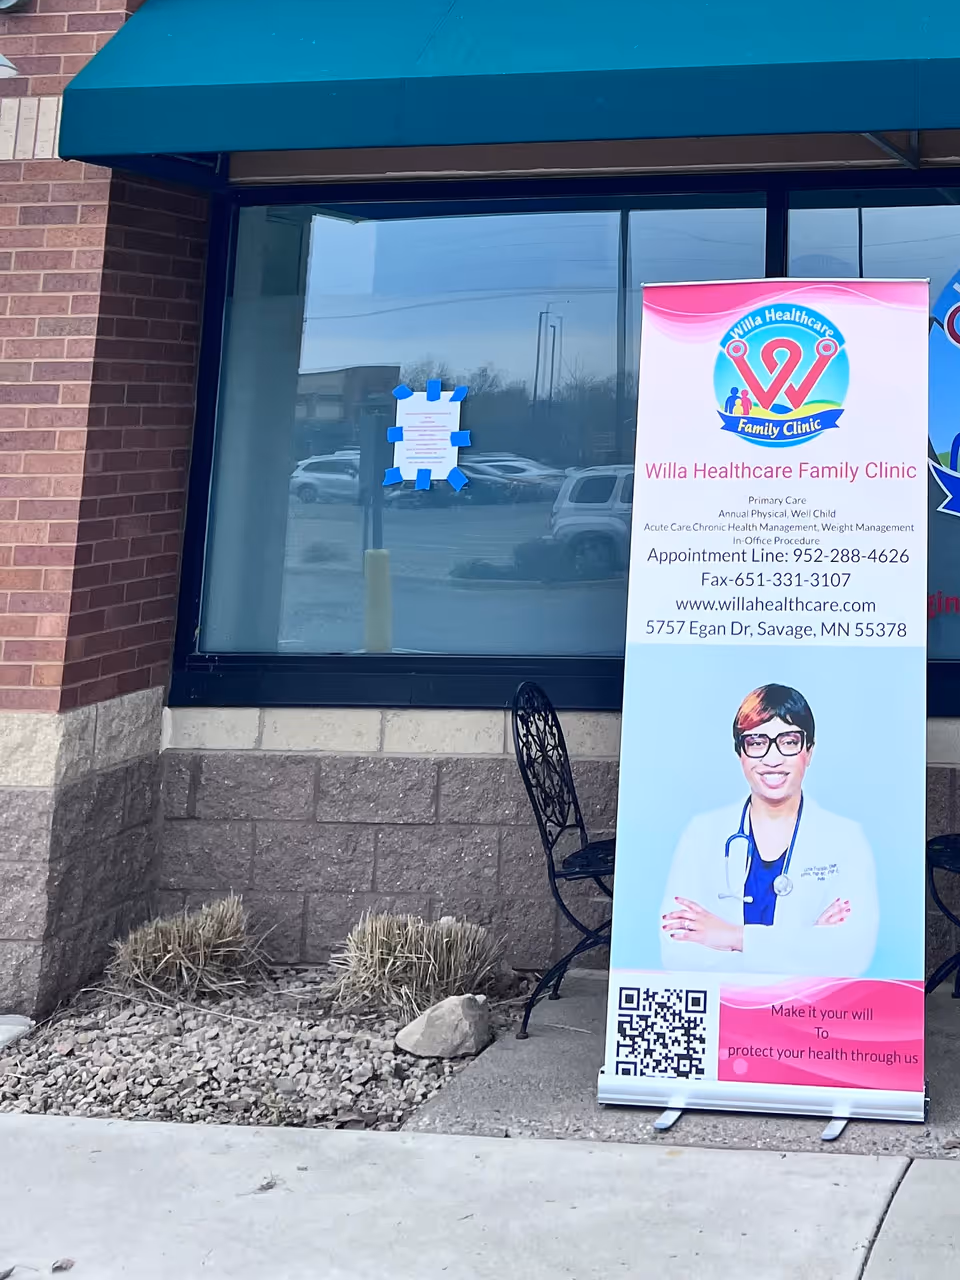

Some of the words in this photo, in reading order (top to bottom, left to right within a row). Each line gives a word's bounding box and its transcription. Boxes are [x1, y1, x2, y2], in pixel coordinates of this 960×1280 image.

[730, 315, 763, 340] Willa
[764, 307, 835, 338] Healthcare
[738, 418, 780, 438] Family
[783, 417, 822, 437] Clinic
[645, 462, 688, 479] Willa
[693, 462, 793, 479] Healthcare
[798, 462, 860, 483] Family
[865, 462, 917, 479] Clinic
[748, 496, 784, 506] Primary
[785, 496, 807, 505] Care
[718, 509, 749, 518] Annual
[751, 509, 788, 519] Physical,
[790, 509, 812, 518] Well
[813, 509, 836, 518] Child
[643, 523, 669, 532] Acute
[728, 523, 758, 532] Health
[759, 523, 820, 534] Management,
[821, 523, 853, 534] Weight
[855, 523, 915, 534] Management
[733, 536, 772, 545] In-Office
[774, 536, 820, 545] Procedure
[647, 548, 747, 565] Appointment
[751, 548, 789, 563] Line:
[793, 548, 910, 564] 952-288-4626
[701, 572, 851, 588] Fax-651-331-3107
[675, 596, 876, 613] www.willahealthcare.com
[645, 620, 686, 635] 5757
[689, 621, 727, 639] Egan
[730, 622, 753, 637] Dr,
[757, 622, 817, 640] Savage,
[821, 622, 851, 637] MN
[854, 622, 908, 638] 55378
[770, 1004, 806, 1018] Make
[807, 1004, 817, 1019] it
[820, 1008, 850, 1022] your
[851, 1007, 873, 1021] will
[814, 1026, 829, 1039] To
[728, 1045, 774, 1060] protect
[776, 1048, 806, 1061] your
[808, 1046, 848, 1062] health
[850, 1048, 901, 1065] through
[904, 1052, 919, 1064] us
